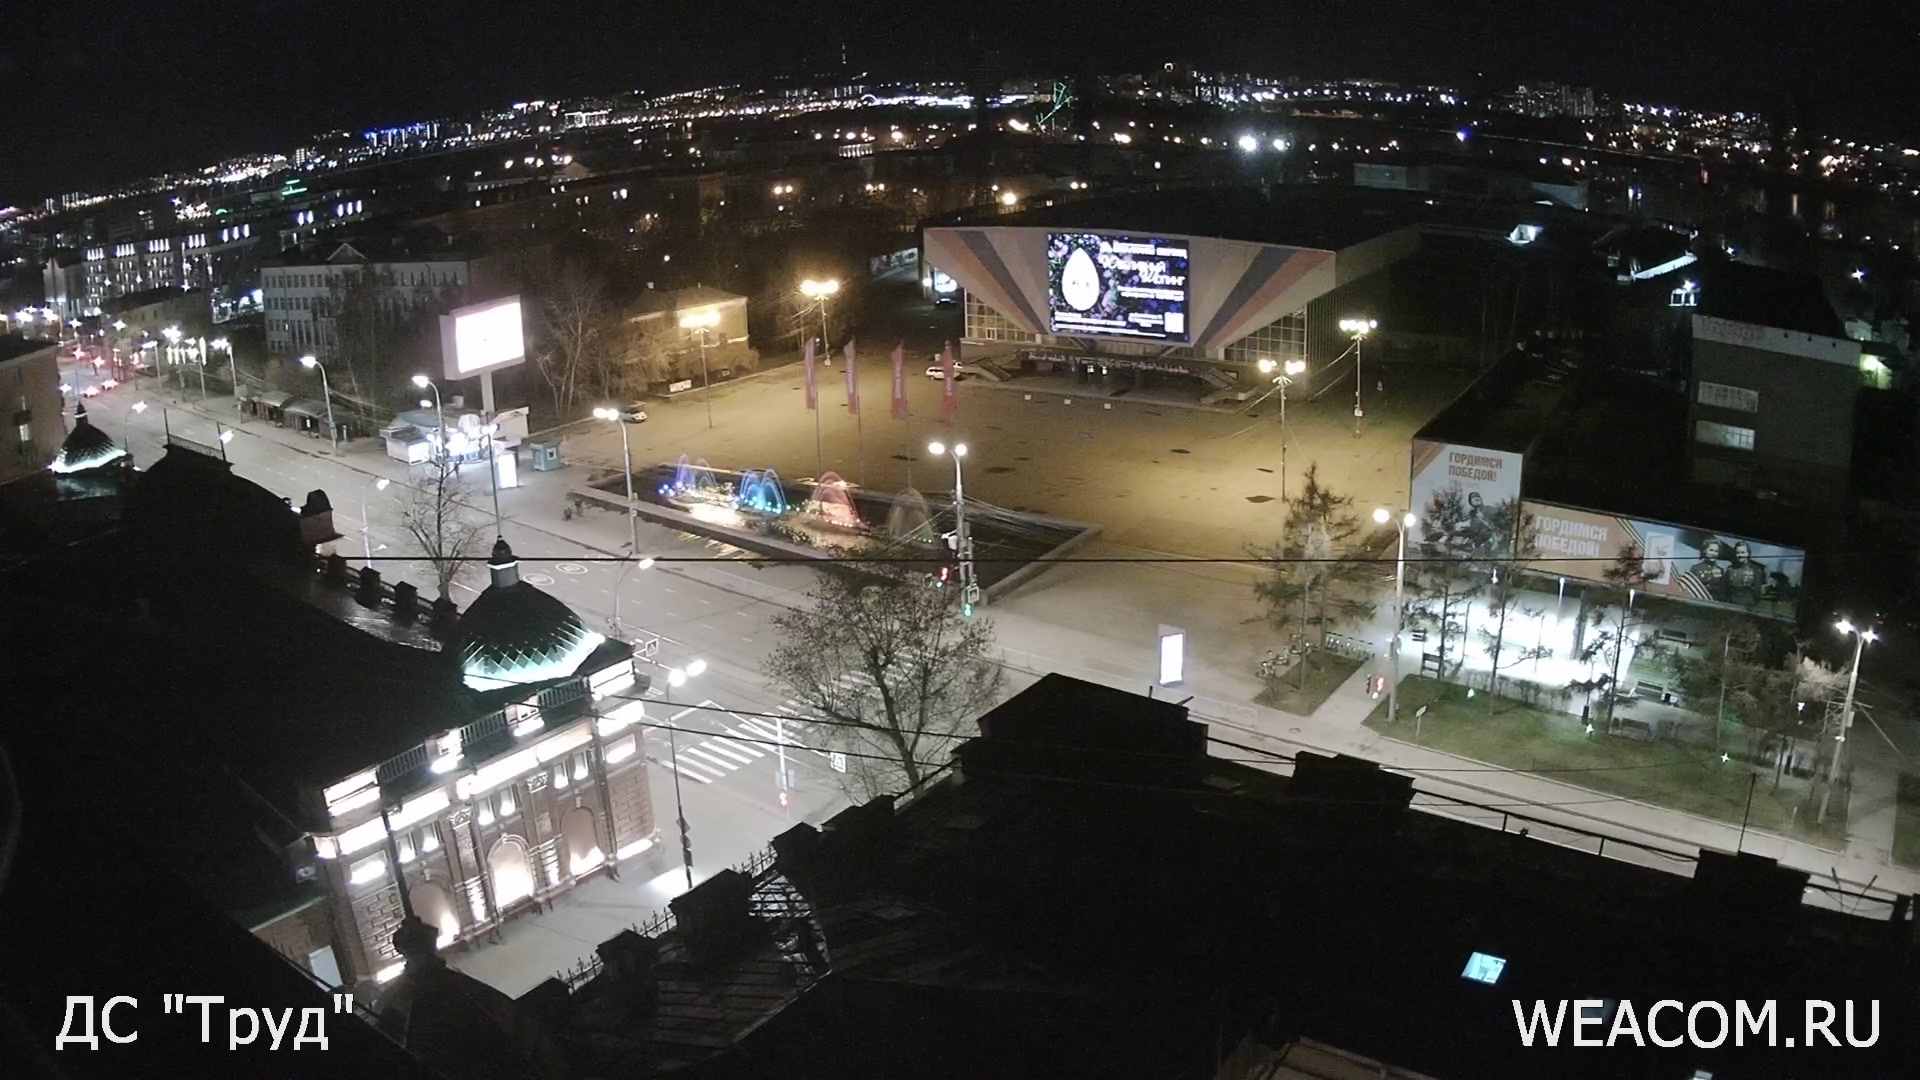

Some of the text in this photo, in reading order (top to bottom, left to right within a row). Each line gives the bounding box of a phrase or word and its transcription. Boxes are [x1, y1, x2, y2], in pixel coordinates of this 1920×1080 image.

[1449, 452, 1503, 469] ГОРДИМСЯ
[1448, 465, 1497, 482] ПОБЕДОЙ!
[1535, 516, 1609, 542] ГОРДИМСЯ
[1534, 533, 1600, 557] ПОБЕДОЙ!
